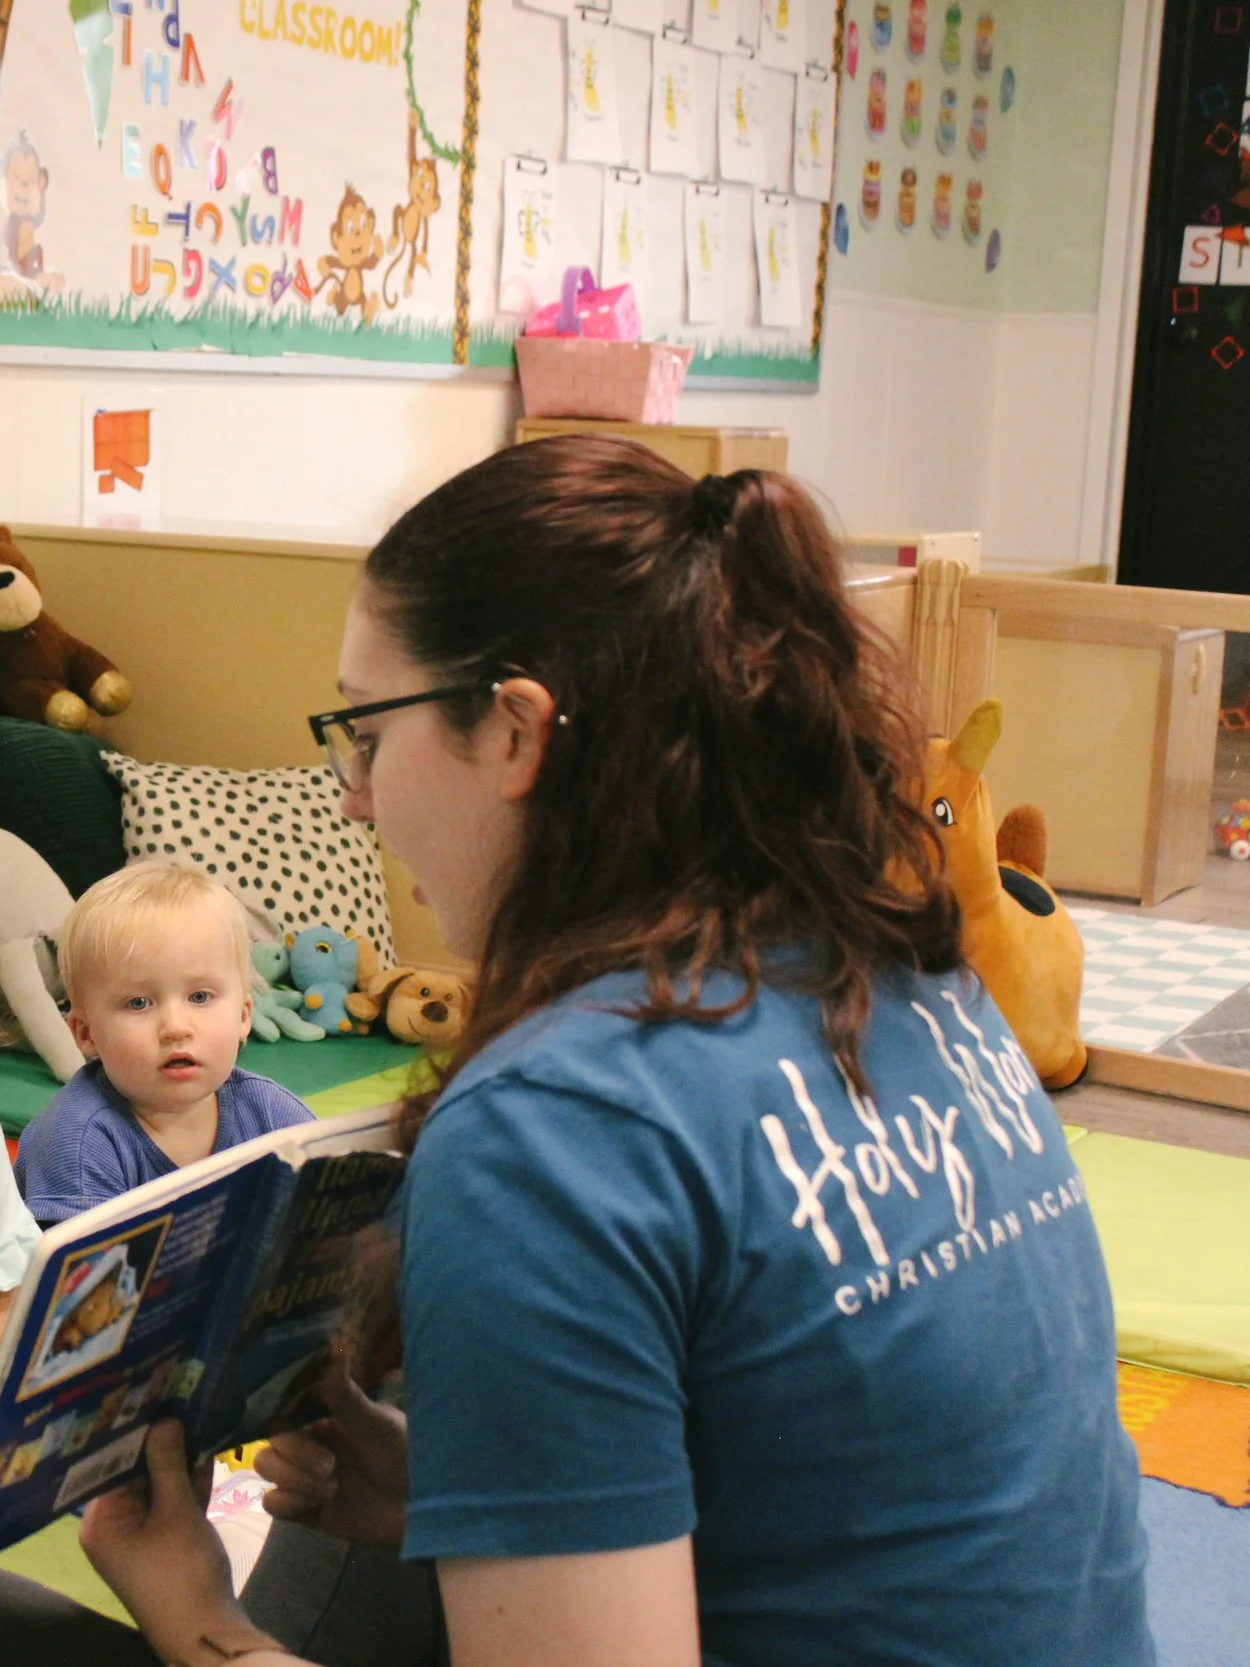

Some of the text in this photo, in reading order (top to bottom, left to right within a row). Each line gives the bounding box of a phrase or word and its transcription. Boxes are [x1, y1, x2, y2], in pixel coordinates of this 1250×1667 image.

[239, 0, 403, 67] CLASSROOM!
[760, 1052, 977, 1267] Holy
[834, 1173, 1087, 1316] CHRISTIAN ACAD
